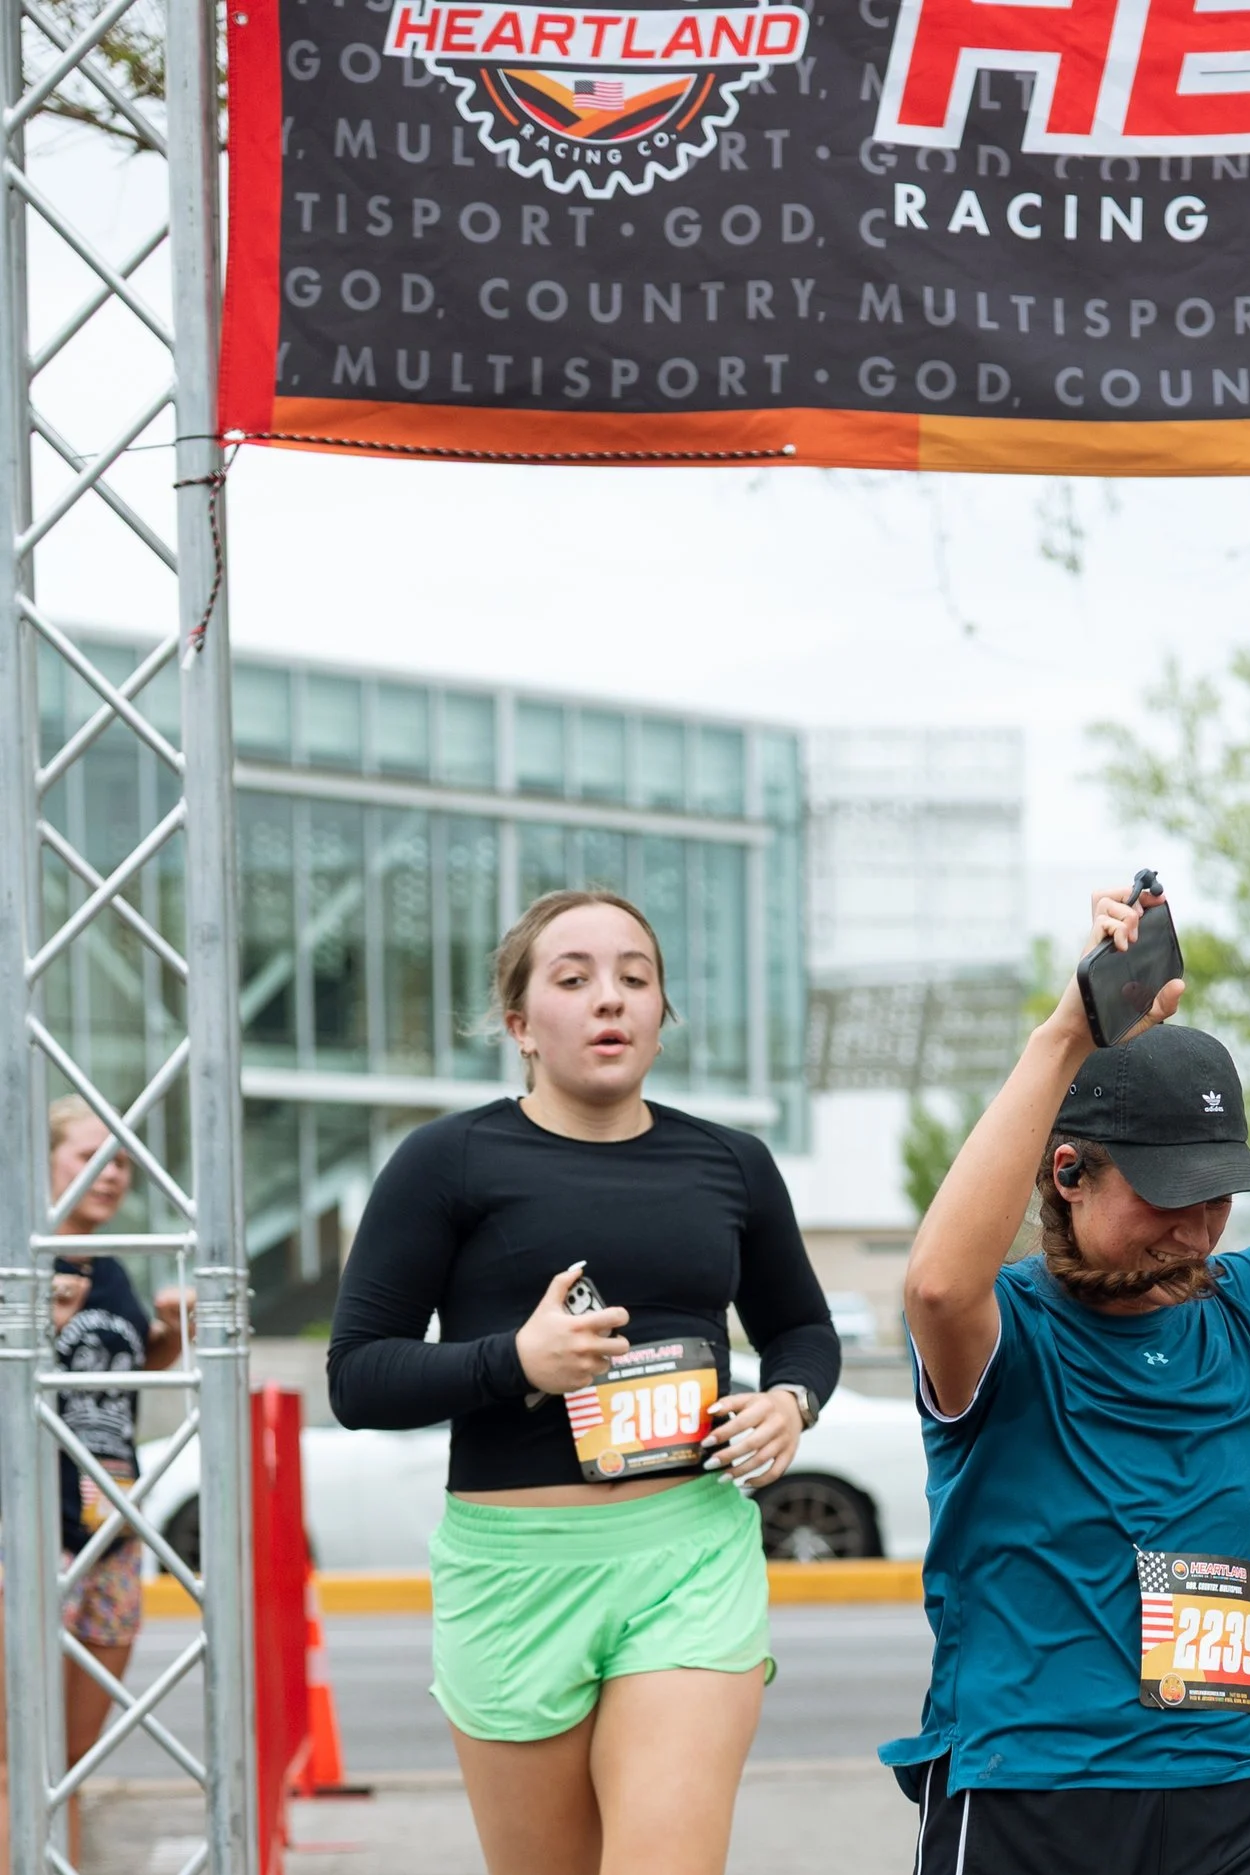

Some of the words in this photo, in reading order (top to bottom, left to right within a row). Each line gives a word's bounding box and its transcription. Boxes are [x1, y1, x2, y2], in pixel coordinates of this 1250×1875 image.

[393, 8, 801, 60] HEARTLAND
[519, 123, 622, 165] RACING
[664, 203, 825, 248] GOD,
[895, 183, 1208, 242] RACING
[285, 266, 445, 320] GOD,
[478, 278, 827, 323] COUNTRY,
[332, 344, 789, 399] MULTISPORT
[858, 356, 1021, 408] GOD,
[610, 1380, 701, 1445] 2189
